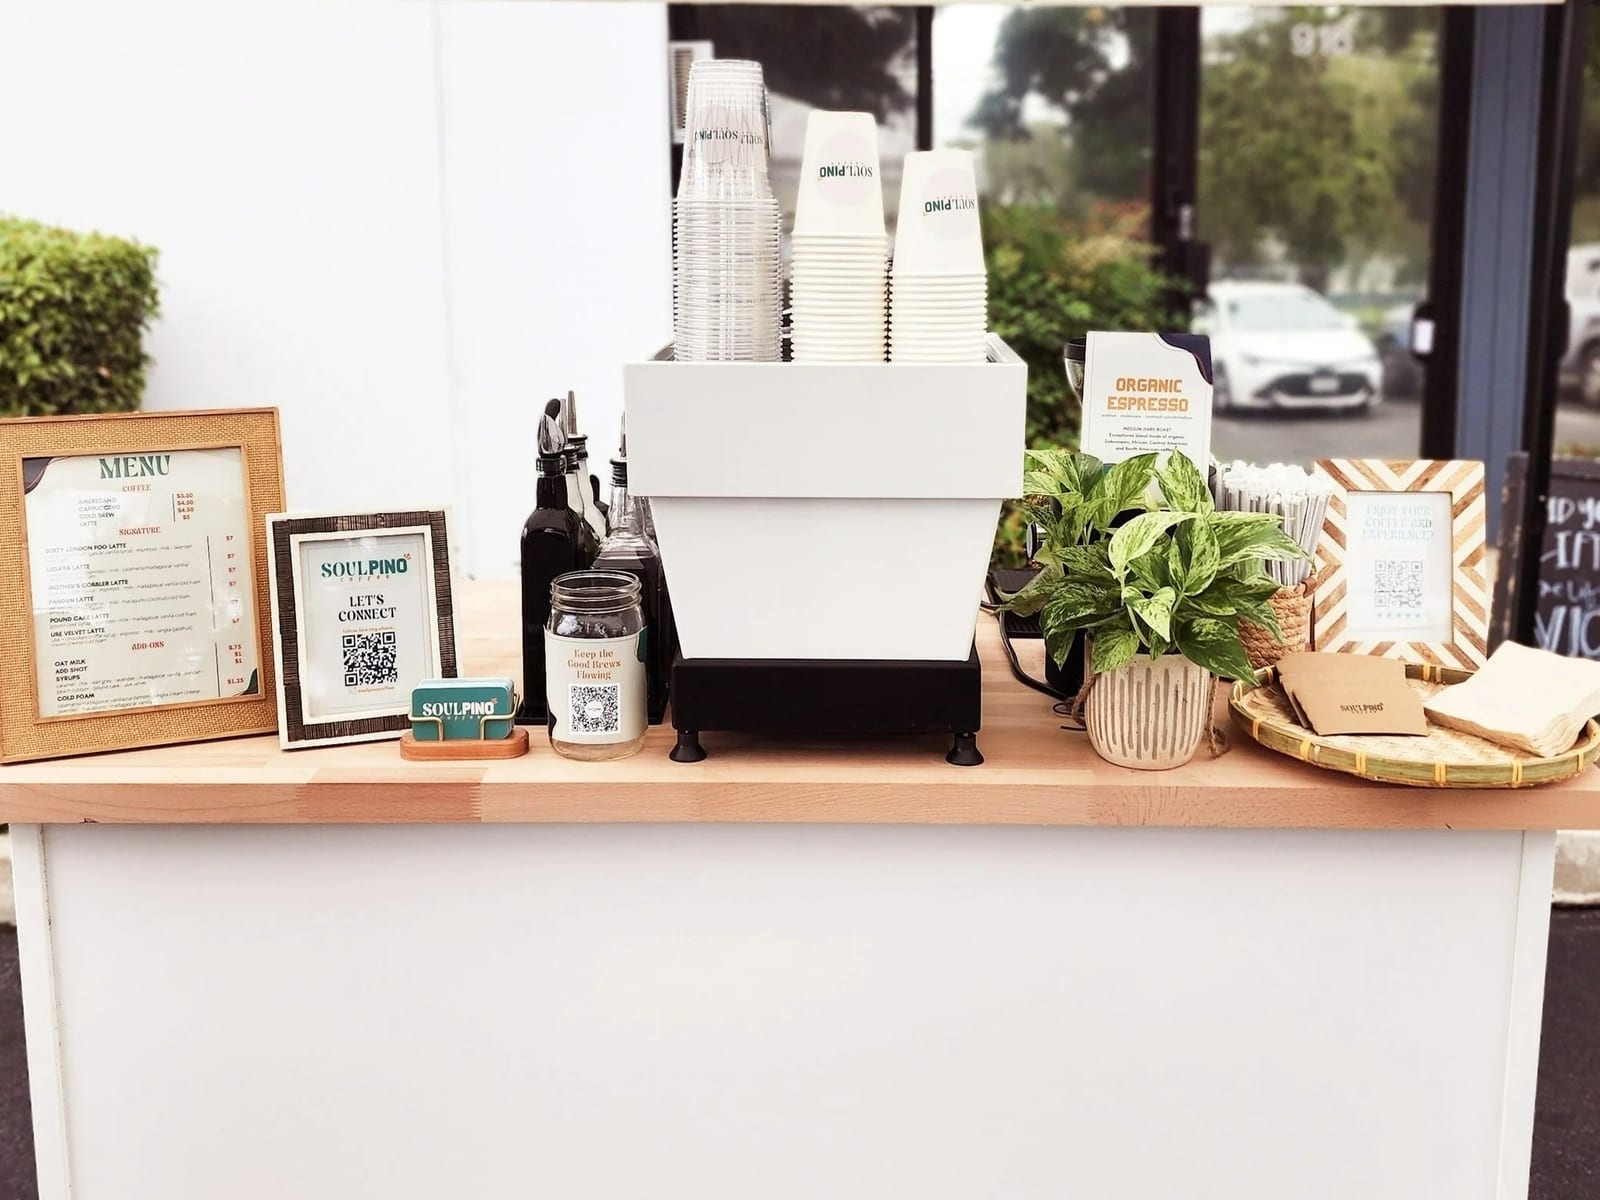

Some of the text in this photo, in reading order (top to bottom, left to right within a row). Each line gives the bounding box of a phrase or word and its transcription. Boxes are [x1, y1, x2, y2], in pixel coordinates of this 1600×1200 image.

[819, 165, 873, 178] SOULPINO
[924, 198, 976, 213] SOULPINO
[1116, 377, 1183, 393] ORGANIC
[1107, 396, 1189, 413] ESPRESSO
[99, 455, 171, 480] MENU
[122, 484, 152, 492] COFFEE
[78, 497, 117, 505] AMERICANO
[79, 512, 97, 520] COLD
[1366, 504, 1431, 517] ENJOY YOUR
[1365, 518, 1432, 529] COFFEE AND
[119, 526, 161, 536] SIGNATURE
[1363, 529, 1435, 541] EXPERIENCE?
[65, 545, 93, 553] LONDON
[108, 542, 127, 550] LATTE
[321, 557, 408, 578] SOULPINO
[81, 580, 110, 589] COBBLER
[75, 595, 94, 603] LATTE
[349, 594, 385, 608] LET'S
[50, 616, 73, 624] POUND
[338, 607, 397, 622] CONNECT
[63, 629, 86, 637] VELVET
[86, 627, 105, 635] LATTE
[131, 640, 165, 651] ADD-ONS
[574, 649, 614, 660] Keep the
[54, 659, 69, 668] OAT
[69, 658, 87, 667] MILK
[567, 660, 621, 669] Good Brews
[55, 667, 69, 675] ADD
[70, 665, 88, 674] SHOT
[577, 670, 612, 680] Flowing
[56, 674, 244, 685] SYRUPS $1.25
[57, 692, 96, 703] COLD FOAM
[422, 701, 495, 717] SOULPINO
